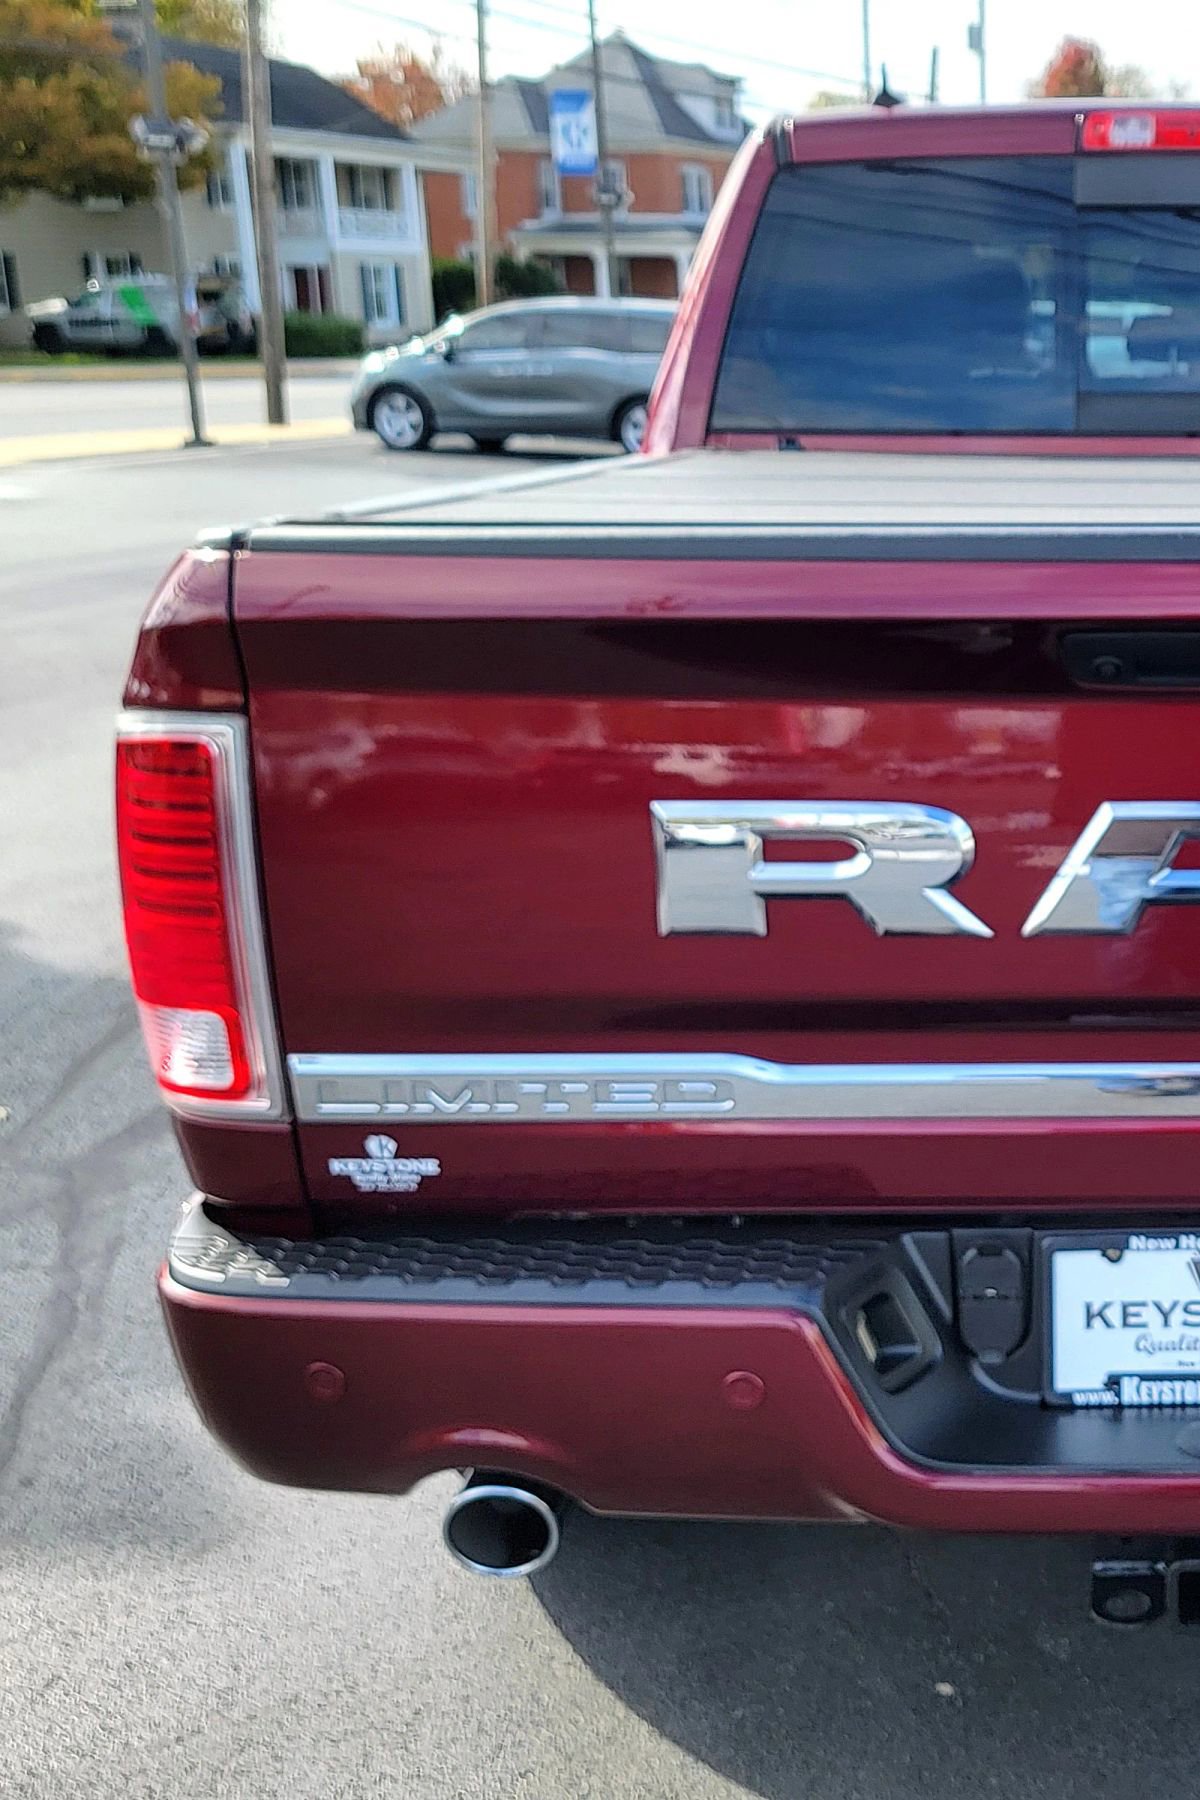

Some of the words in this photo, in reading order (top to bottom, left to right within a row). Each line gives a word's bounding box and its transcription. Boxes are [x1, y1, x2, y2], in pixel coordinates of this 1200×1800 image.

[315, 1079, 737, 1114] LIMITED
[328, 1158, 441, 1176] KEYSTONE
[1128, 1234, 1177, 1250] New
